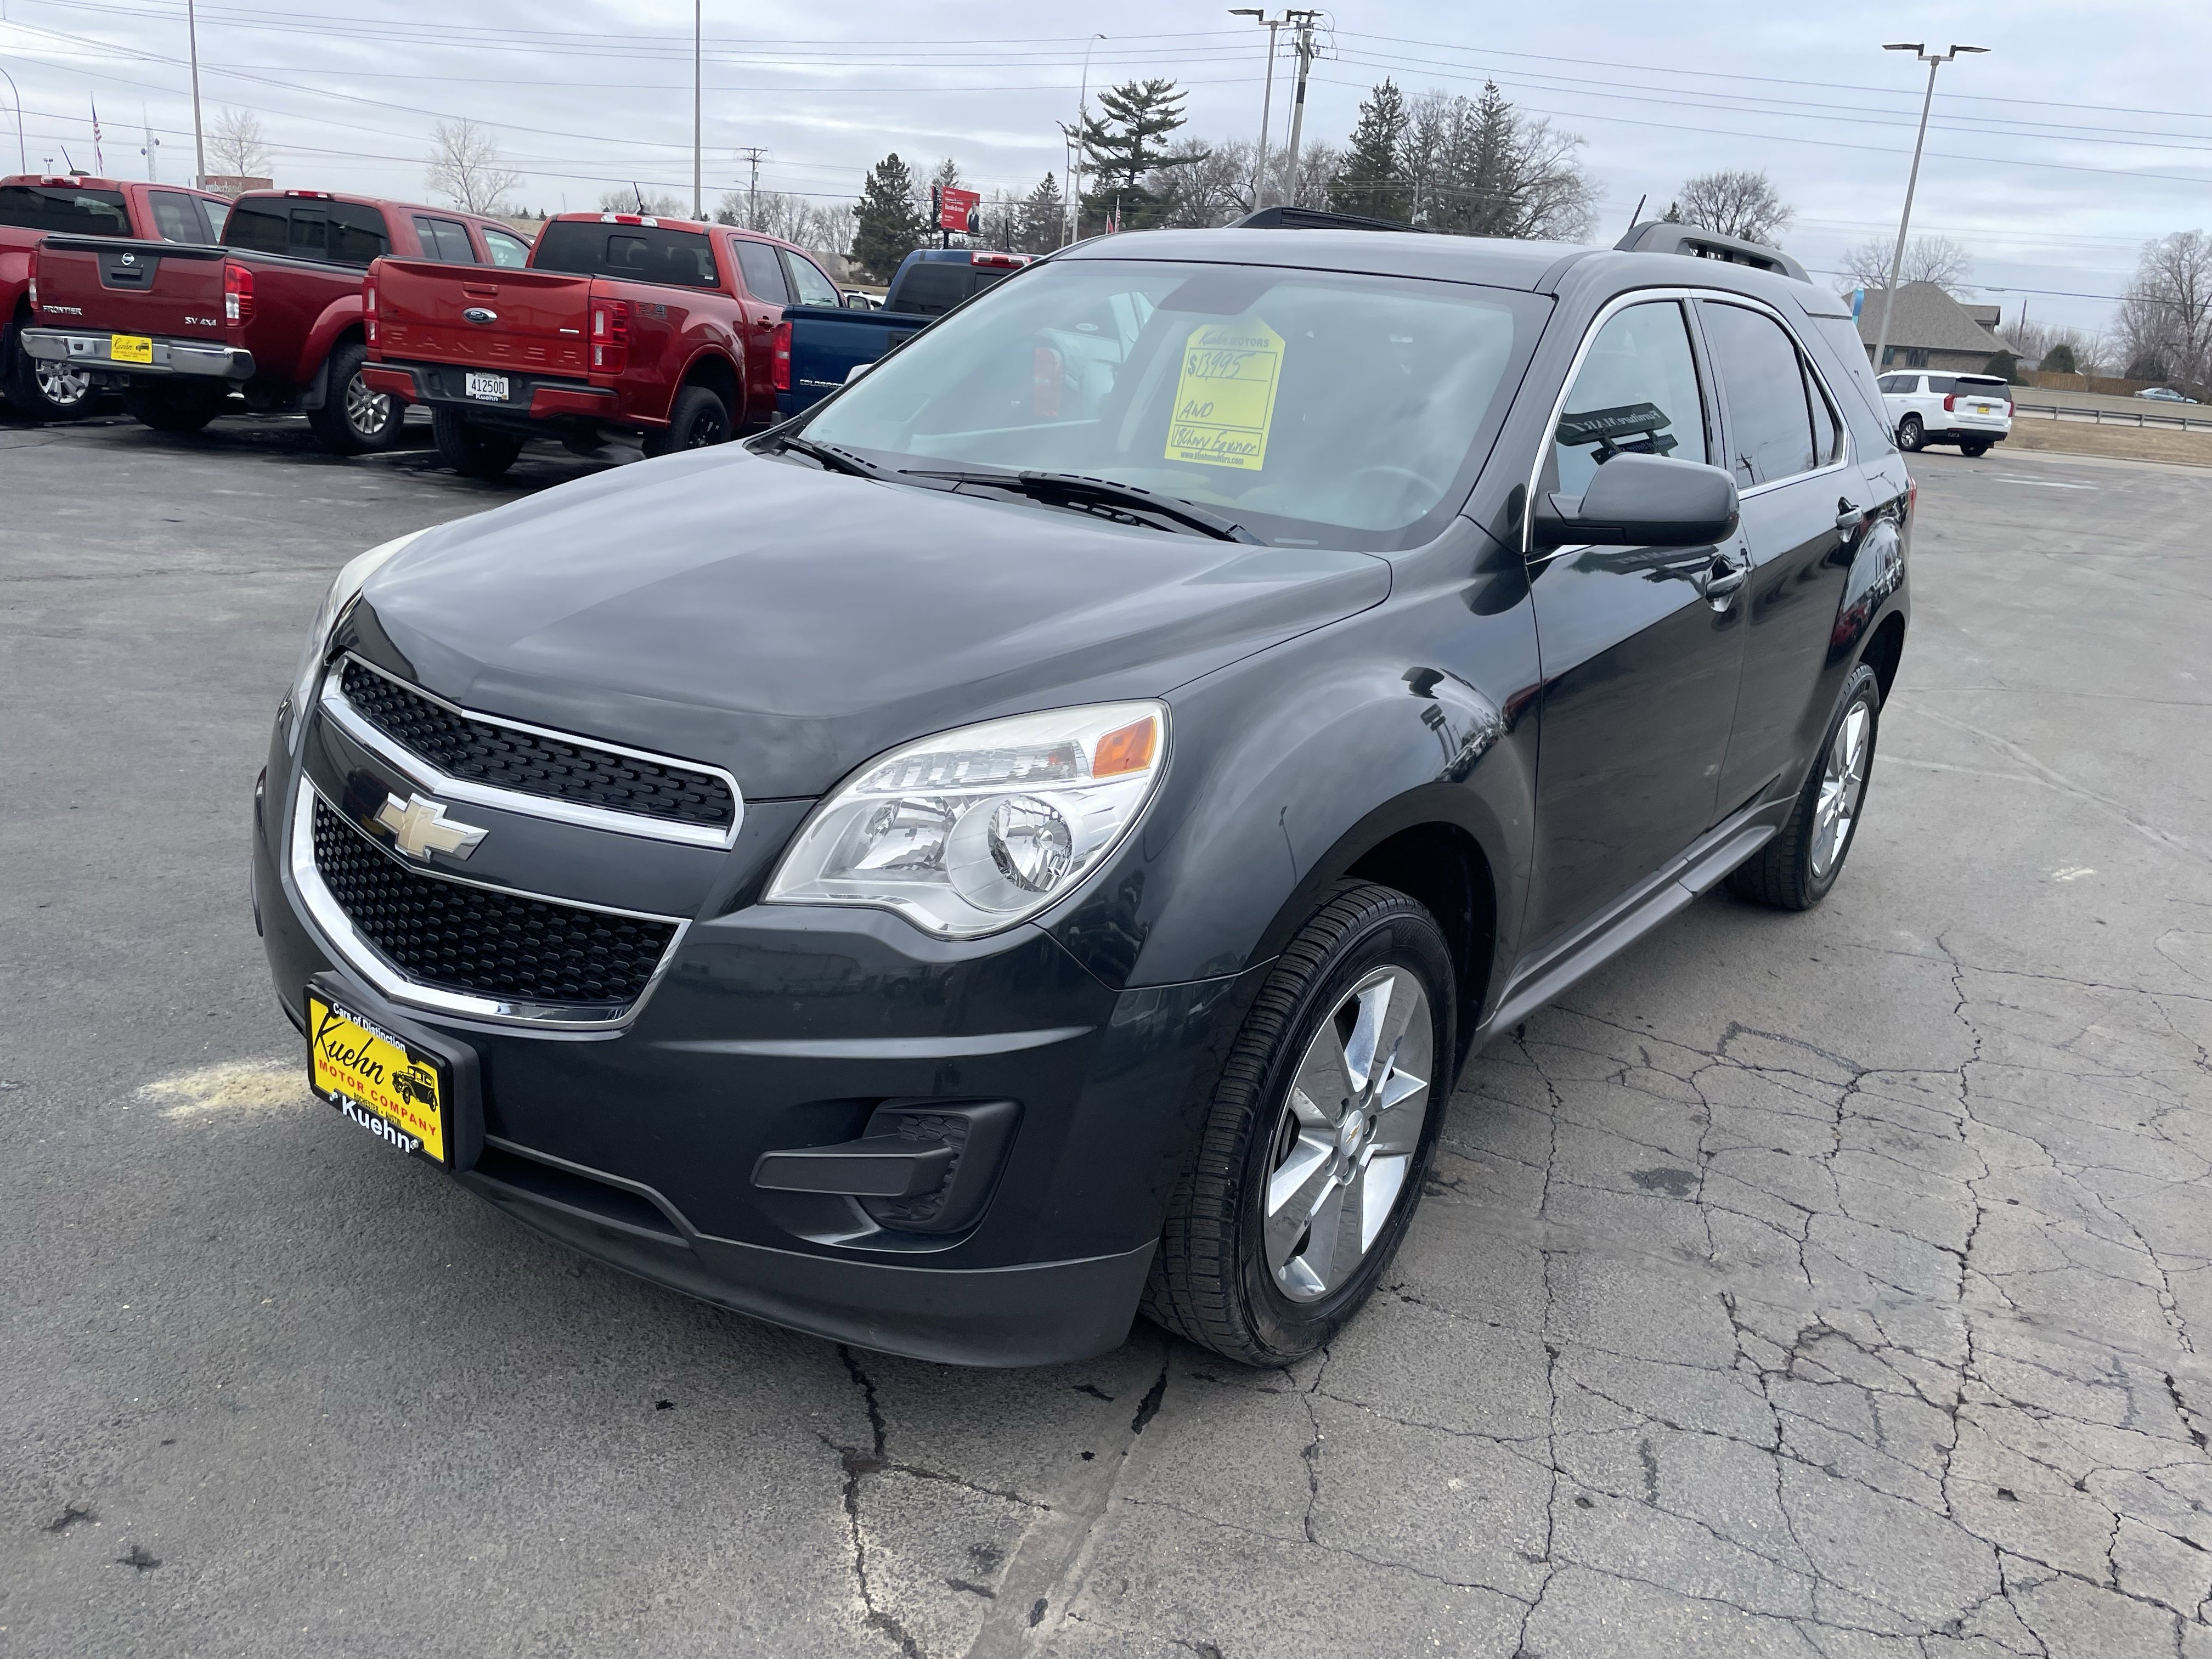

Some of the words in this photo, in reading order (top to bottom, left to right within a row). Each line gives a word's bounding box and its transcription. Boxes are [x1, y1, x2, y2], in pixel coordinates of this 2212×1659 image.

[43, 305, 82, 315] FRONTIER
[185, 317, 198, 325] SV
[1230, 336, 1269, 348] MOTORS
[472, 379, 504, 394] 41250D
[1179, 399, 1214, 420] AWD
[333, 1003, 352, 1021] Cars
[353, 1016, 362, 1026] of
[362, 1019, 406, 1053] Distinction
[314, 1013, 385, 1085] Kuehn
[319, 1059, 365, 1094] MOTOR
[371, 1090, 436, 1136] COMPANY
[353, 1092, 379, 1114] ROCHESTER
[385, 1111, 402, 1127] AUSTIN
[342, 1095, 410, 1153] Kuehn
